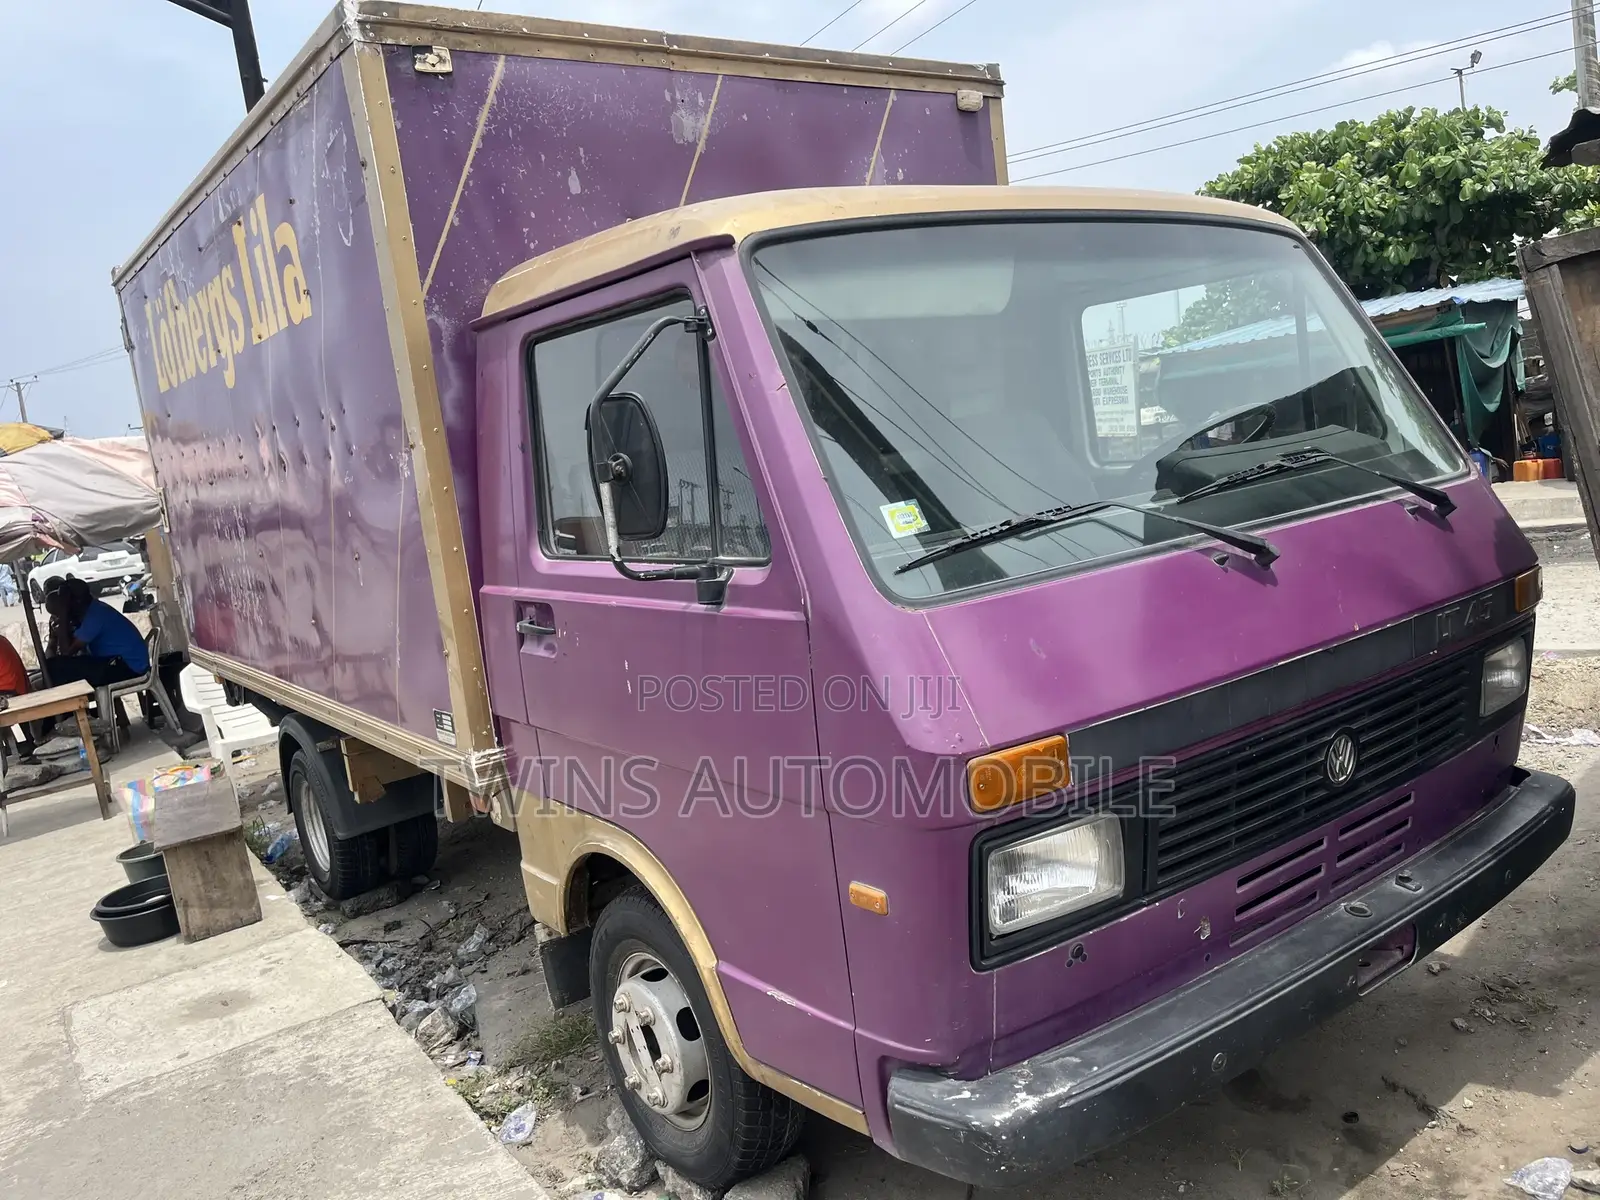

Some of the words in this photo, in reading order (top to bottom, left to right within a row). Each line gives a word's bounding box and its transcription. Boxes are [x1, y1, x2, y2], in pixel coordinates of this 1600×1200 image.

[144, 264, 245, 393] Löfbergs
[231, 192, 312, 345] Lila
[1100, 350, 1121, 366] SERVICES
